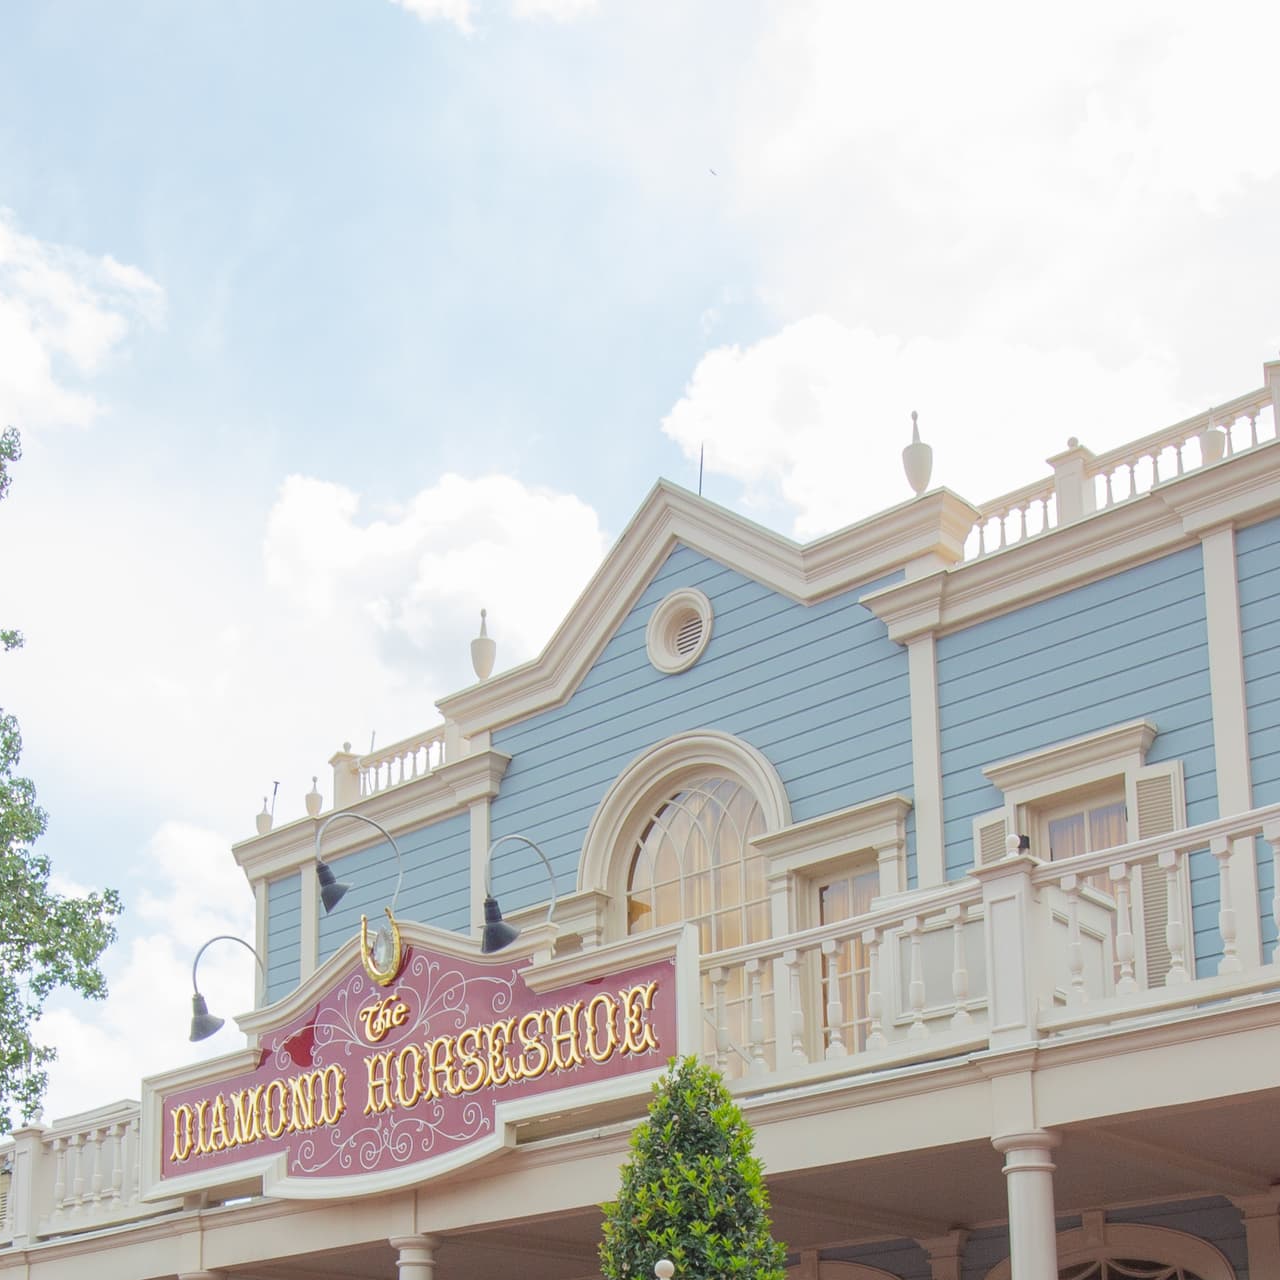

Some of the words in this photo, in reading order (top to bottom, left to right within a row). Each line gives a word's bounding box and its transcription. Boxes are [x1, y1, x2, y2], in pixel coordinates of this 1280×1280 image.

[169, 1063, 347, 1162] DIAMOND
[363, 980, 660, 1116] HORSESHOE
[359, 995, 410, 1042] The
